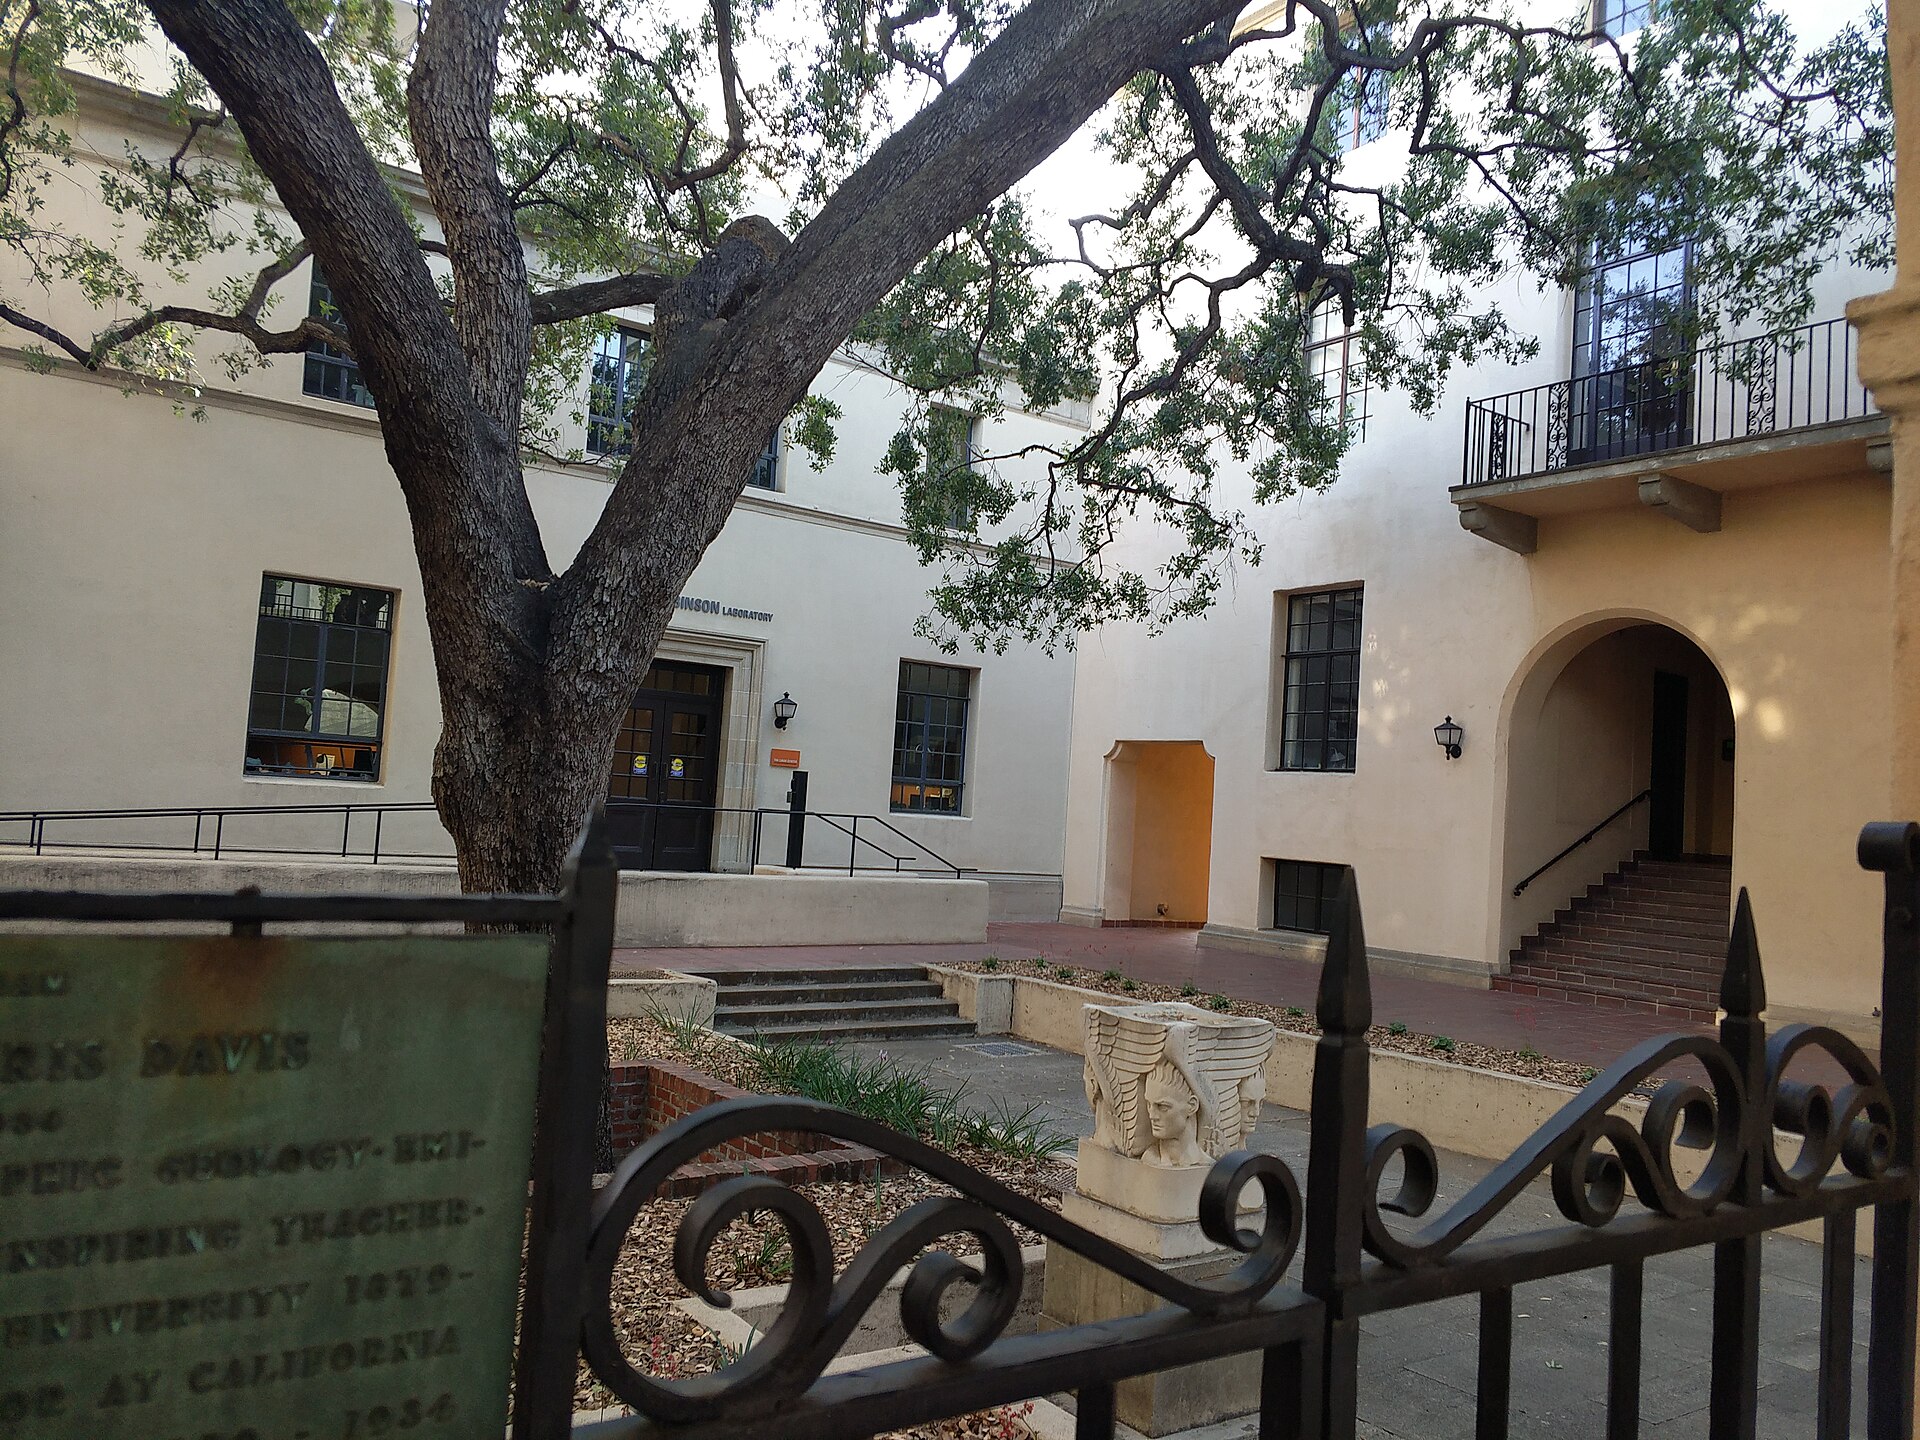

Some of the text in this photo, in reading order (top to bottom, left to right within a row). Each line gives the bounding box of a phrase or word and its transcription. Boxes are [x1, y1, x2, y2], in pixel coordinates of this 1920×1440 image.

[722, 606, 774, 622] LABORATORY
[140, 1030, 310, 1078] DAVIS
[187, 1325, 462, 1395] CALIFORNIA
